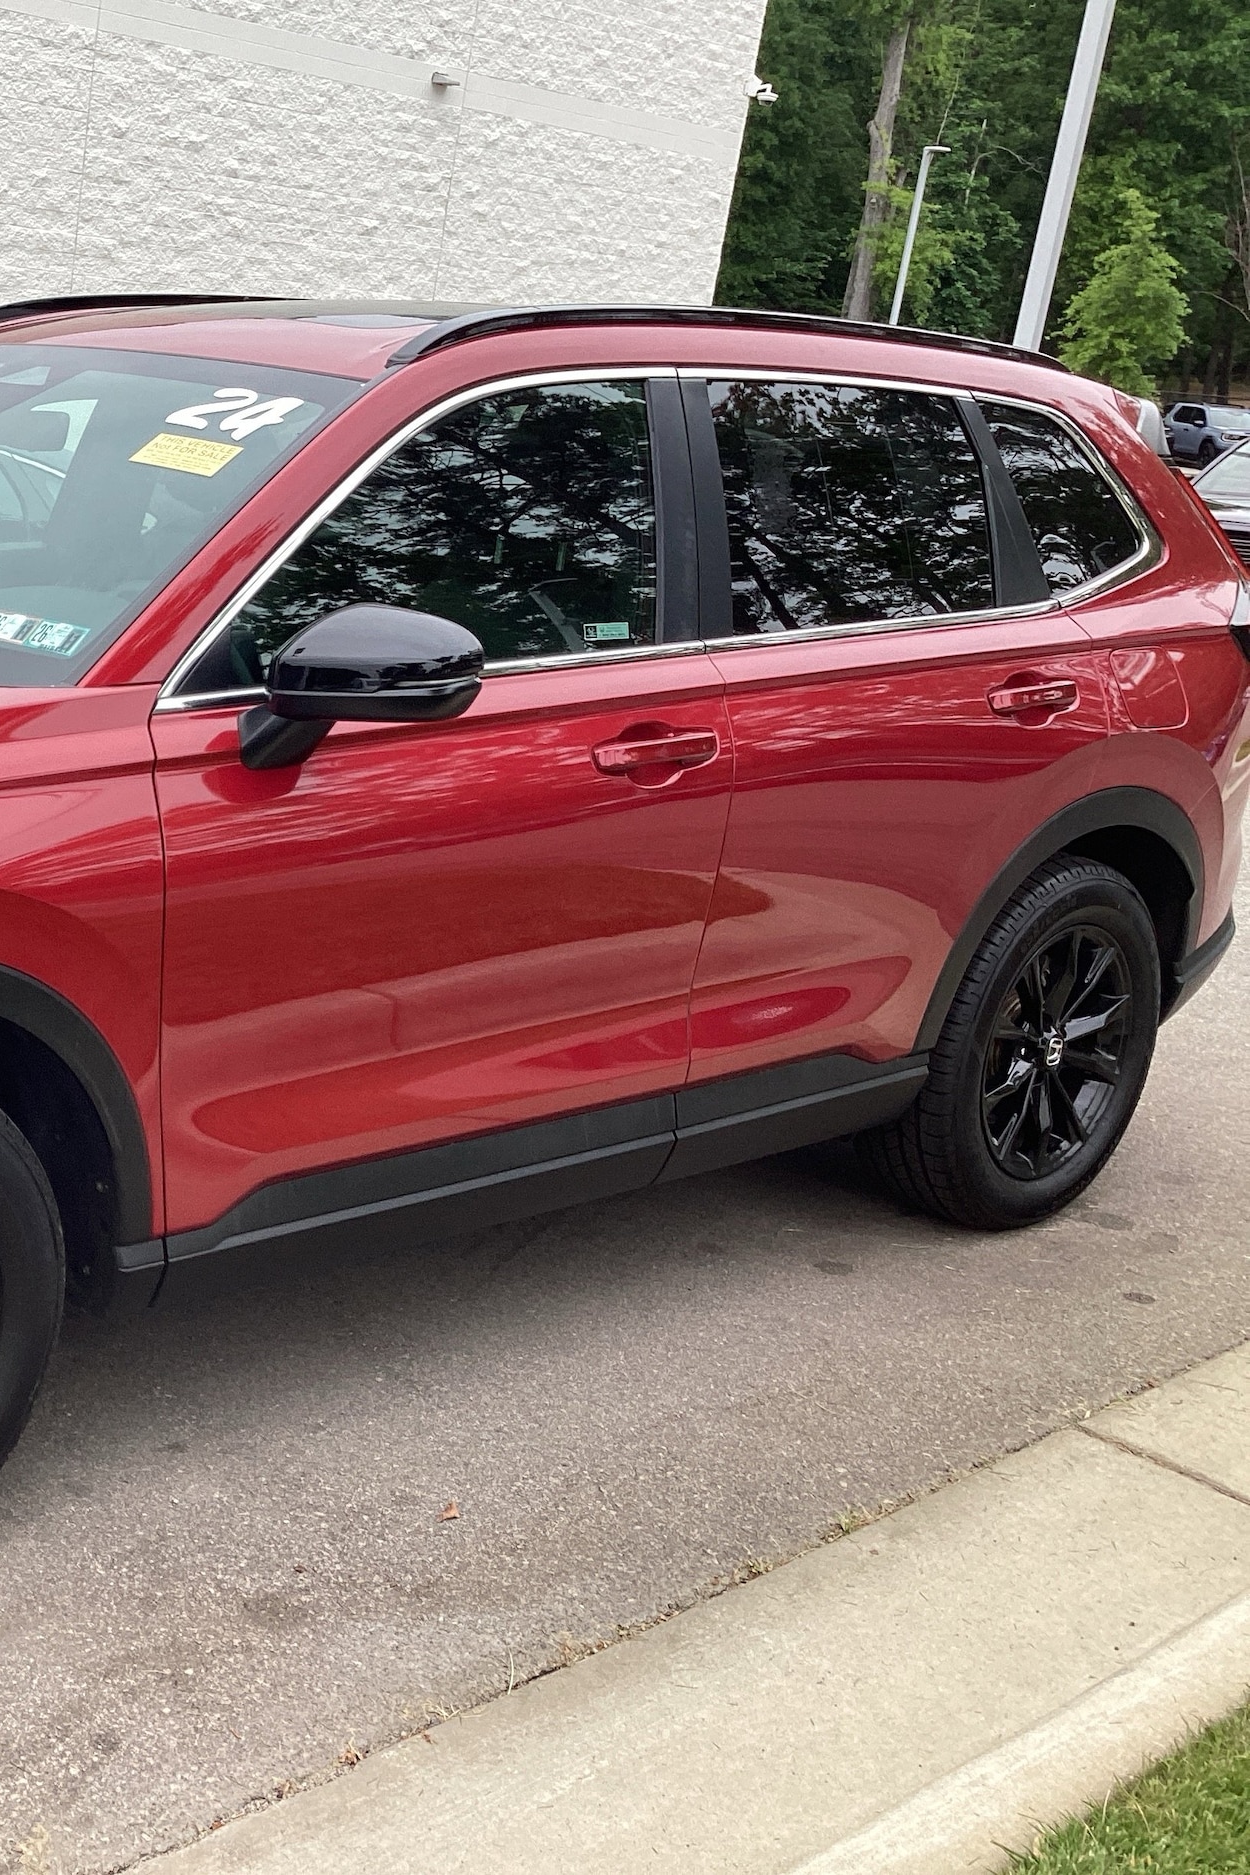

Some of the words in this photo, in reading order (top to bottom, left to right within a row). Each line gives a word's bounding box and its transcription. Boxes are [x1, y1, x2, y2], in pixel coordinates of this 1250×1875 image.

[165, 387, 305, 441] 24
[160, 436, 186, 445] THIS
[188, 440, 237, 455] VEHICLE
[172, 445, 197, 455] FOR
[198, 449, 231, 461] SALE
[31, 623, 54, 643] 26
